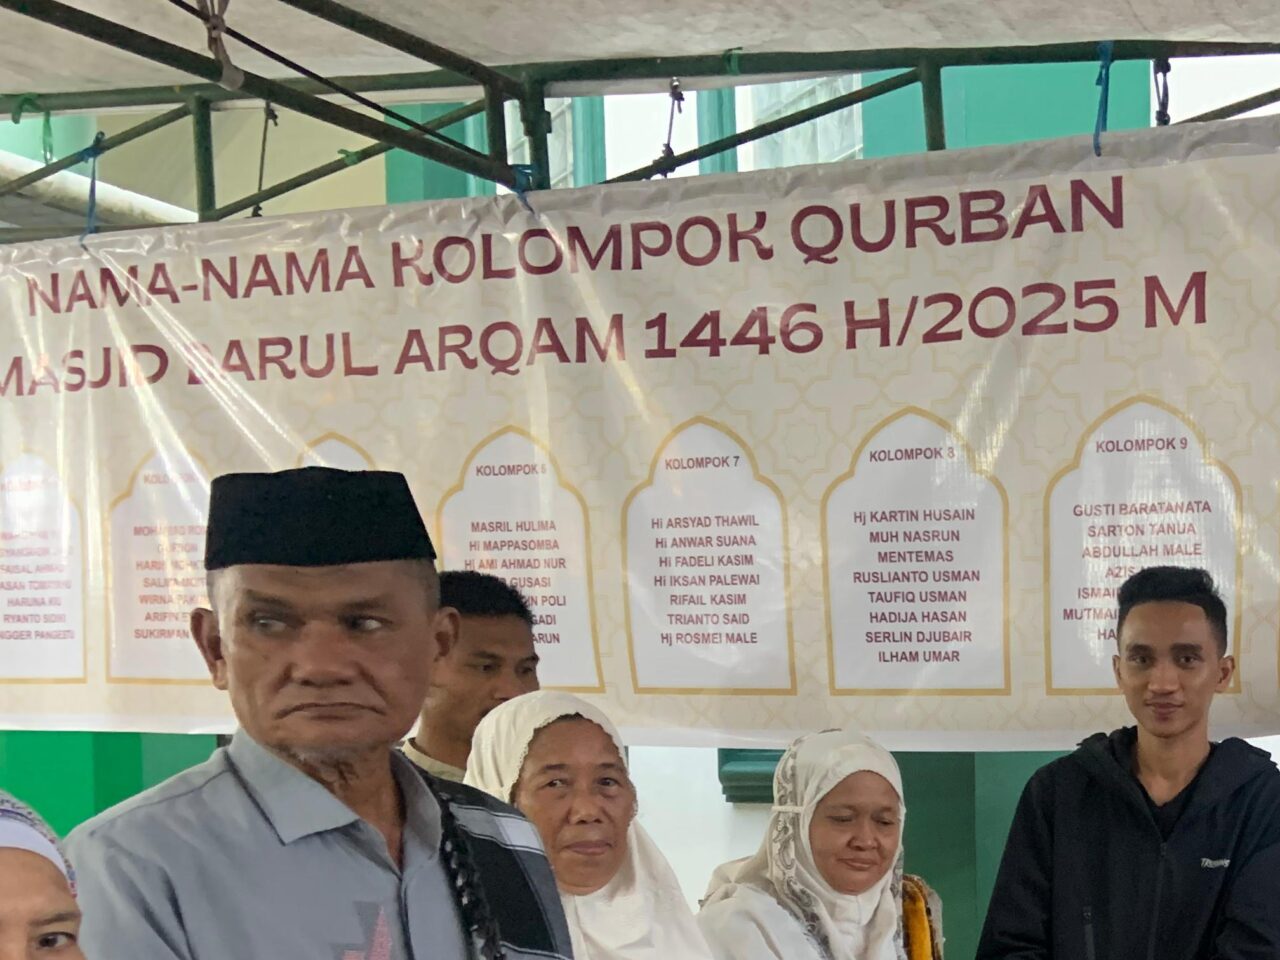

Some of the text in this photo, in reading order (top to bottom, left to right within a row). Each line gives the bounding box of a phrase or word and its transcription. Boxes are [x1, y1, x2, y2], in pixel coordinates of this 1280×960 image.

[27, 175, 1124, 316] NAMA-NAMA KOLOMPOK QURBAN
[394, 313, 625, 375] ARQAM
[645, 303, 823, 359] 1446
[844, 279, 1119, 349] H/2025
[1144, 271, 1206, 328] M
[1096, 437, 1188, 453] KOLOMPOK 9
[870, 448, 943, 462] KOLOMPOK
[665, 456, 740, 470] KOLOMPOK 7
[476, 464, 538, 476] KOLOMPOK
[1073, 501, 1212, 517] GUSTI BARATANATA
[651, 515, 759, 529] Hi ARSYAD THAWIL
[854, 509, 975, 525] Hj KARTIN HUSAIN
[471, 521, 556, 533] MASRIL HULIMA
[1088, 523, 1196, 537] SARTON TANUA
[655, 535, 757, 548] Hi ANWAR SUANA
[870, 530, 960, 543] MUH NASRUN
[469, 539, 559, 551] Hi MAPPASOMBA
[1082, 544, 1202, 558] ABDULLAH MALE
[659, 555, 754, 567] Hi FADELI KASIM
[878, 551, 954, 563] MENTEMAS
[478, 559, 497, 570] AMI
[501, 558, 540, 569] AHMAD
[544, 558, 566, 569] NUR
[510, 577, 551, 588] GUSASI
[654, 574, 760, 587] Hi IKSAN PALEWAI
[853, 570, 980, 583] RUSLIANTO USMAN
[541, 595, 566, 606] POLI
[670, 594, 747, 605] RIFAIL KASIM
[867, 591, 967, 603] TAUFIQ USMAN
[531, 615, 556, 625] GADI
[667, 613, 750, 625] TRIANTO SAID
[870, 611, 966, 623] HADIJA HASAN
[1063, 608, 1118, 620] MUTMAI
[533, 633, 560, 644] ARUN
[661, 632, 757, 646] Hj ROSMEI MALE
[865, 630, 972, 643] SERLIN DJUBAIR
[878, 650, 960, 663] ILHAM UMAR
